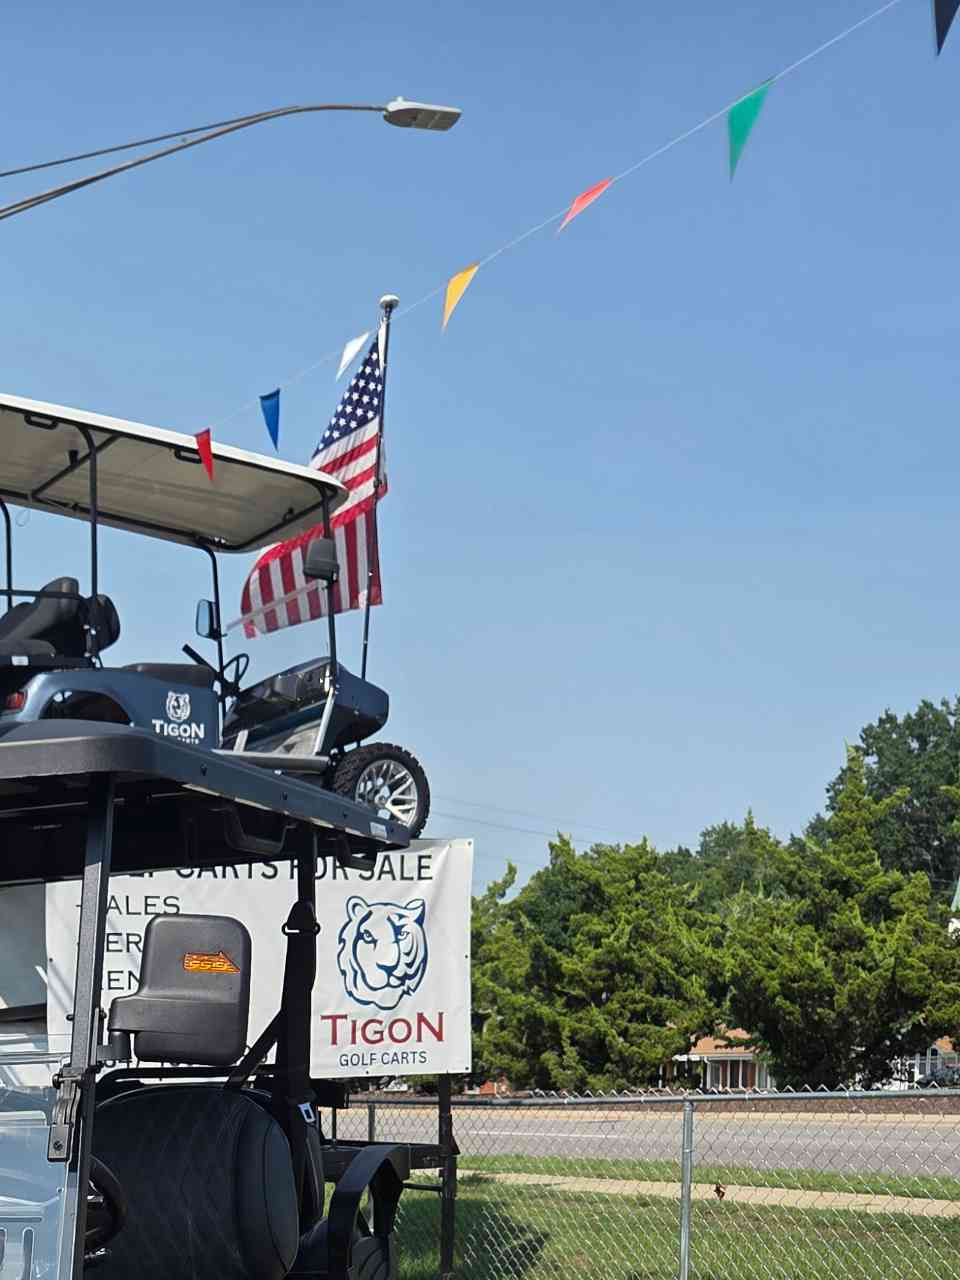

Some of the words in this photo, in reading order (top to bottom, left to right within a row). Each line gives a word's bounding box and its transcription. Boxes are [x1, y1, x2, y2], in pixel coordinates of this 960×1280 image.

[152, 719, 204, 739] TIGON
[105, 895, 181, 916] ALES
[320, 1011, 445, 1046] TIGON
[339, 1052, 377, 1067] GOLF
[381, 1050, 427, 1065] CARTS
